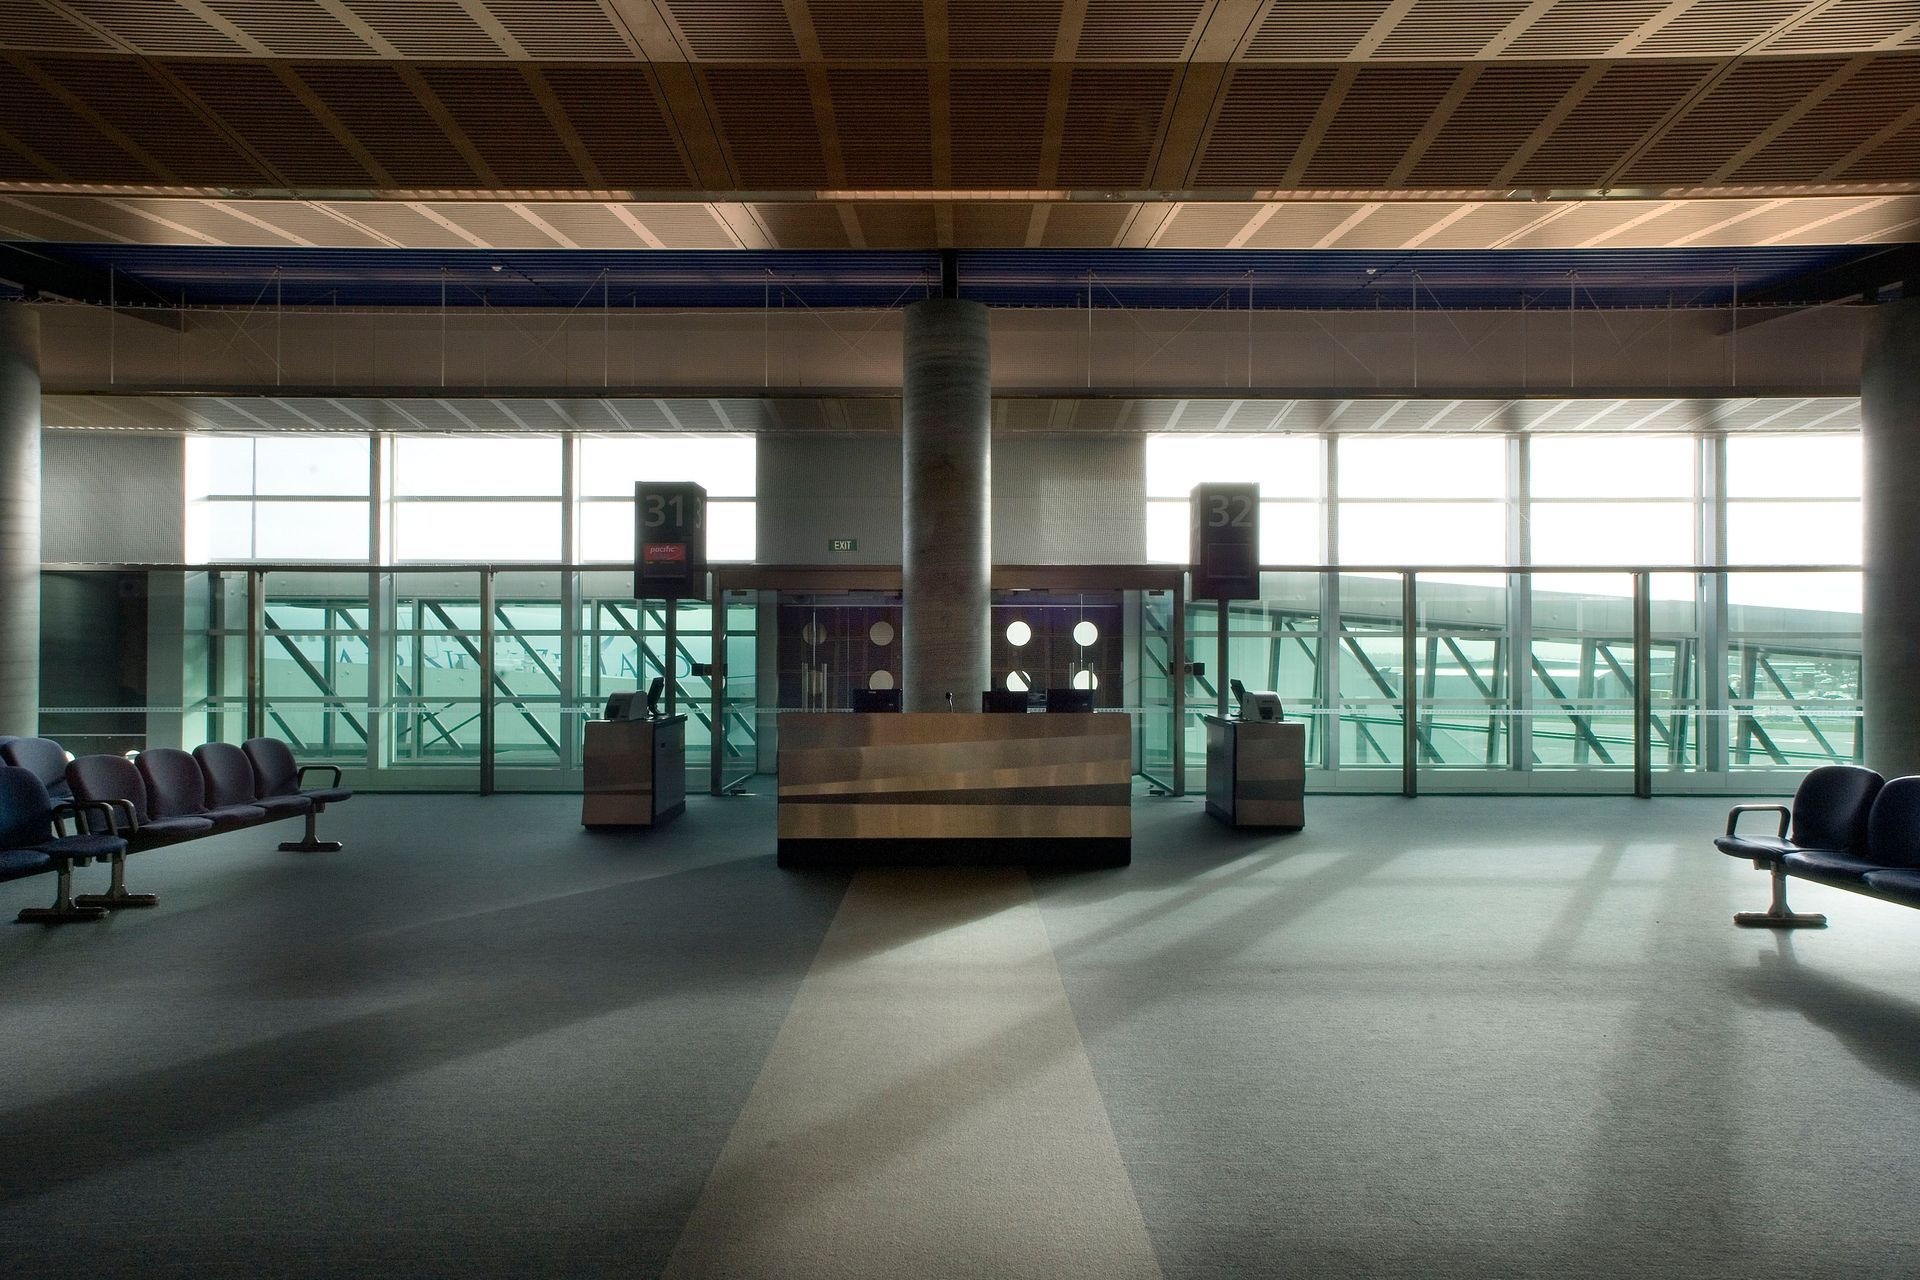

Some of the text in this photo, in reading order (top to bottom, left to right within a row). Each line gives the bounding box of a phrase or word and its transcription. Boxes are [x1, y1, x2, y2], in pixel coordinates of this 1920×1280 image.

[644, 495, 683, 527] 31
[1208, 495, 1252, 527] 32
[834, 540, 851, 550] EXIT
